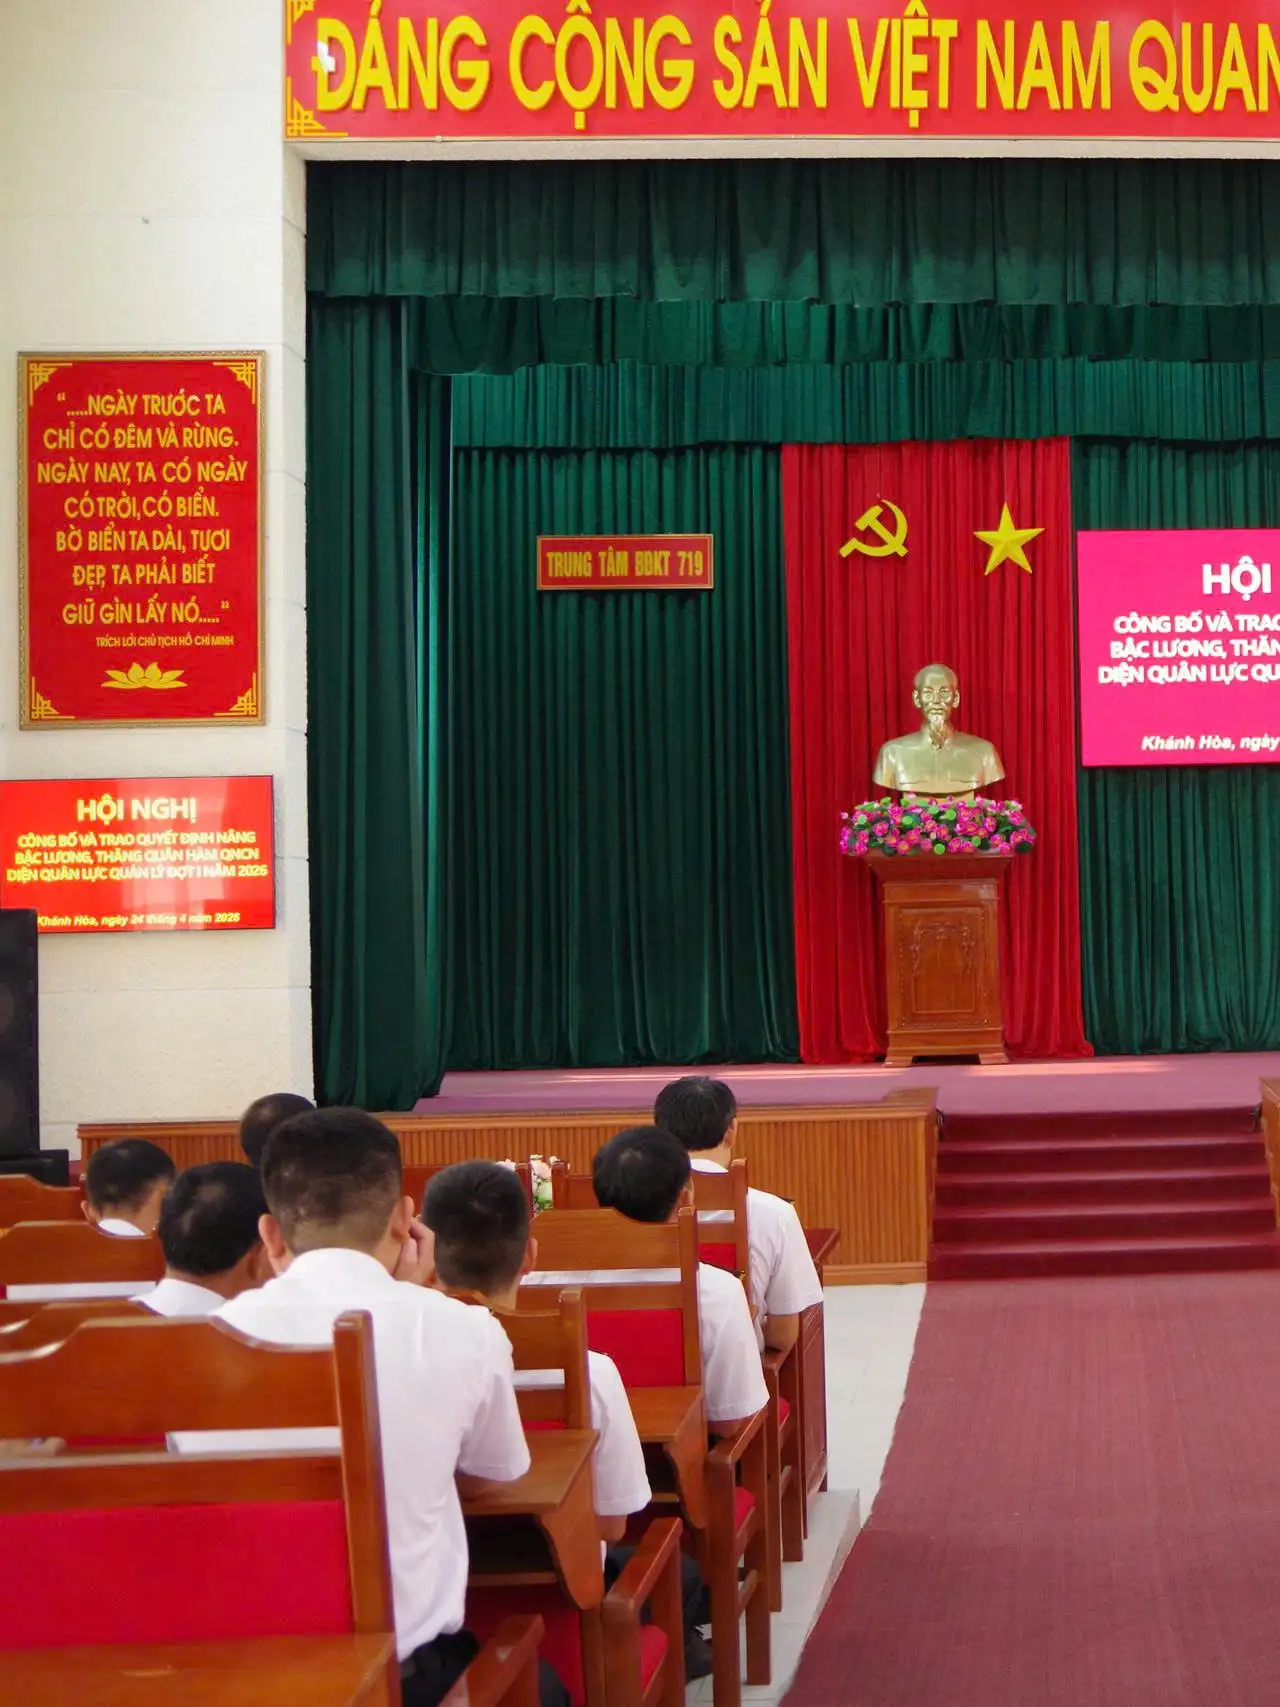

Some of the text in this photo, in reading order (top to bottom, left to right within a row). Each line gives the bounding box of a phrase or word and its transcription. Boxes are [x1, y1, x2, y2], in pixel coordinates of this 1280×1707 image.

[509, 0, 694, 129] CỘNG
[847, 0, 959, 128] VIỆT
[976, 20, 1110, 110] NAM
[143, 388, 200, 416] TRƯỚC
[205, 394, 226, 414] TA
[43, 421, 75, 449] CHỈ
[80, 422, 110, 449] CÓ
[114, 423, 151, 448] ĐÊM
[156, 422, 179, 448] VÀ
[37, 455, 247, 485] NGÀY NAY, TA CÓ NGÀY
[64, 490, 94, 518] CÓ
[143, 490, 172, 517] CÓ
[56, 524, 82, 551] BỜ
[88, 522, 125, 551] BIỂN
[129, 531, 149, 551] TA
[152, 524, 186, 552] DÀI,
[112, 564, 132, 584] TA
[136, 557, 176, 584] PHẢI
[182, 554, 216, 584] BIẾT
[546, 551, 592, 577] TRUNG
[598, 545, 628, 576] TÂM
[677, 551, 704, 576] 719
[1202, 555, 1272, 601] HỘI
[62, 598, 96, 624] GIỮ
[100, 597, 132, 624] GÌN
[136, 593, 168, 623] LẤY
[1113, 611, 1172, 633] CÔNG
[1174, 610, 1204, 633] BỐ
[1205, 610, 1233, 632] VÀ
[1110, 636, 1150, 662] BẬC
[1098, 662, 1144, 687] DIỆN
[1147, 660, 1207, 685] QUÂN
[1210, 662, 1248, 686] LỰC
[1141, 735, 1195, 750] Khánh
[1240, 734, 1280, 752] ngày
[78, 793, 196, 826] HỘI NGHỊ
